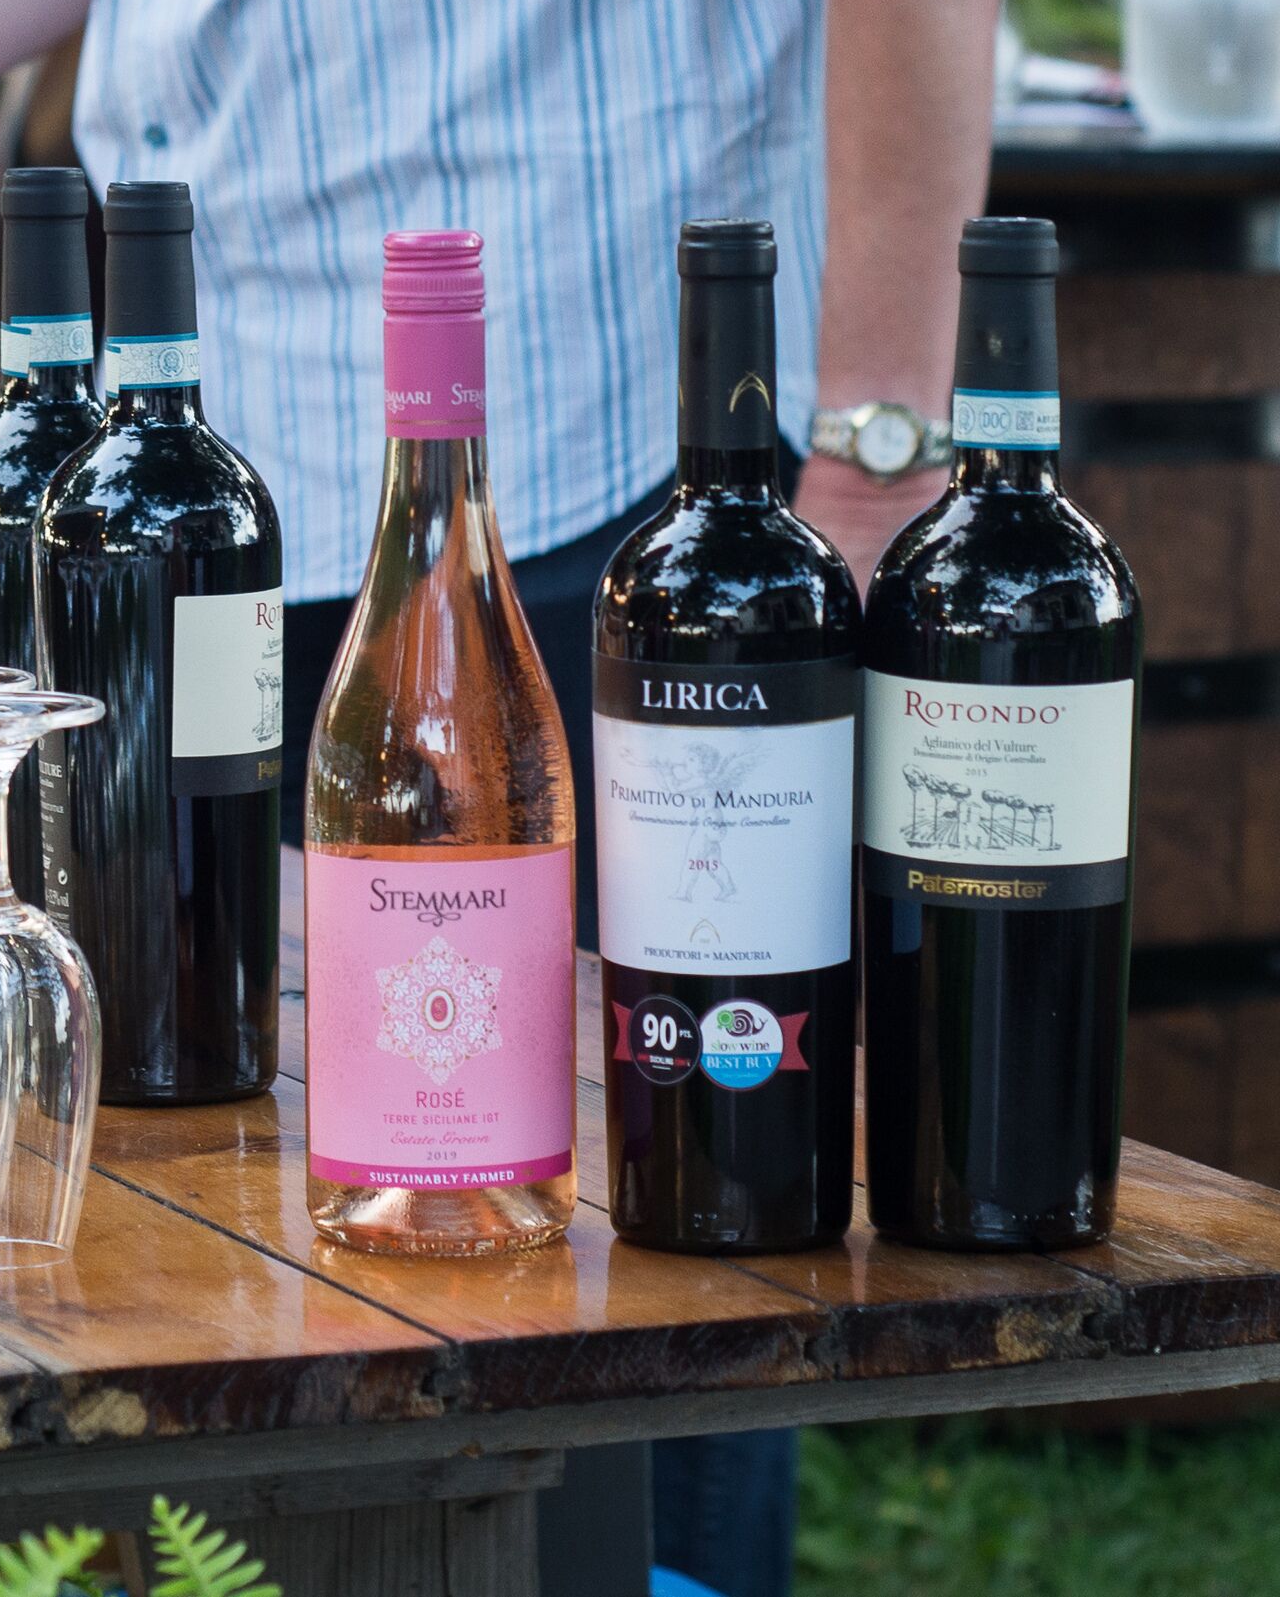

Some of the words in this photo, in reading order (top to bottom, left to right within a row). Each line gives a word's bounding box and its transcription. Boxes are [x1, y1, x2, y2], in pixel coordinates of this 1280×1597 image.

[983, 412, 1007, 429] DOC
[642, 680, 768, 711] LIRICA
[904, 690, 1059, 728] ROTONDO
[923, 735, 972, 750] Aglianico
[974, 740, 991, 752] del
[995, 740, 1038, 753] Vulture
[610, 779, 685, 808] PRIMITIVO
[713, 789, 814, 810] MANDURIA
[688, 859, 719, 871] 2015
[908, 870, 1047, 899] Paternoster
[370, 879, 506, 926] STEMMARI
[644, 946, 701, 961] PRODUTTORI
[712, 951, 772, 961] MANDURIA
[643, 1013, 677, 1051] 90
[740, 1040, 770, 1052] wine
[707, 1056, 740, 1069] BEST
[745, 1056, 774, 1068] BUY
[416, 1088, 465, 1109] ROSÉ
[383, 1114, 418, 1125] TERRE
[422, 1114, 478, 1125] SICILIANE
[482, 1112, 500, 1124] IGT
[391, 1131, 436, 1145] Estate
[440, 1131, 490, 1145] Grown
[426, 1151, 457, 1161] 2019
[370, 1171, 459, 1185] SUSTAINABLY
[463, 1170, 515, 1184] FARMED
